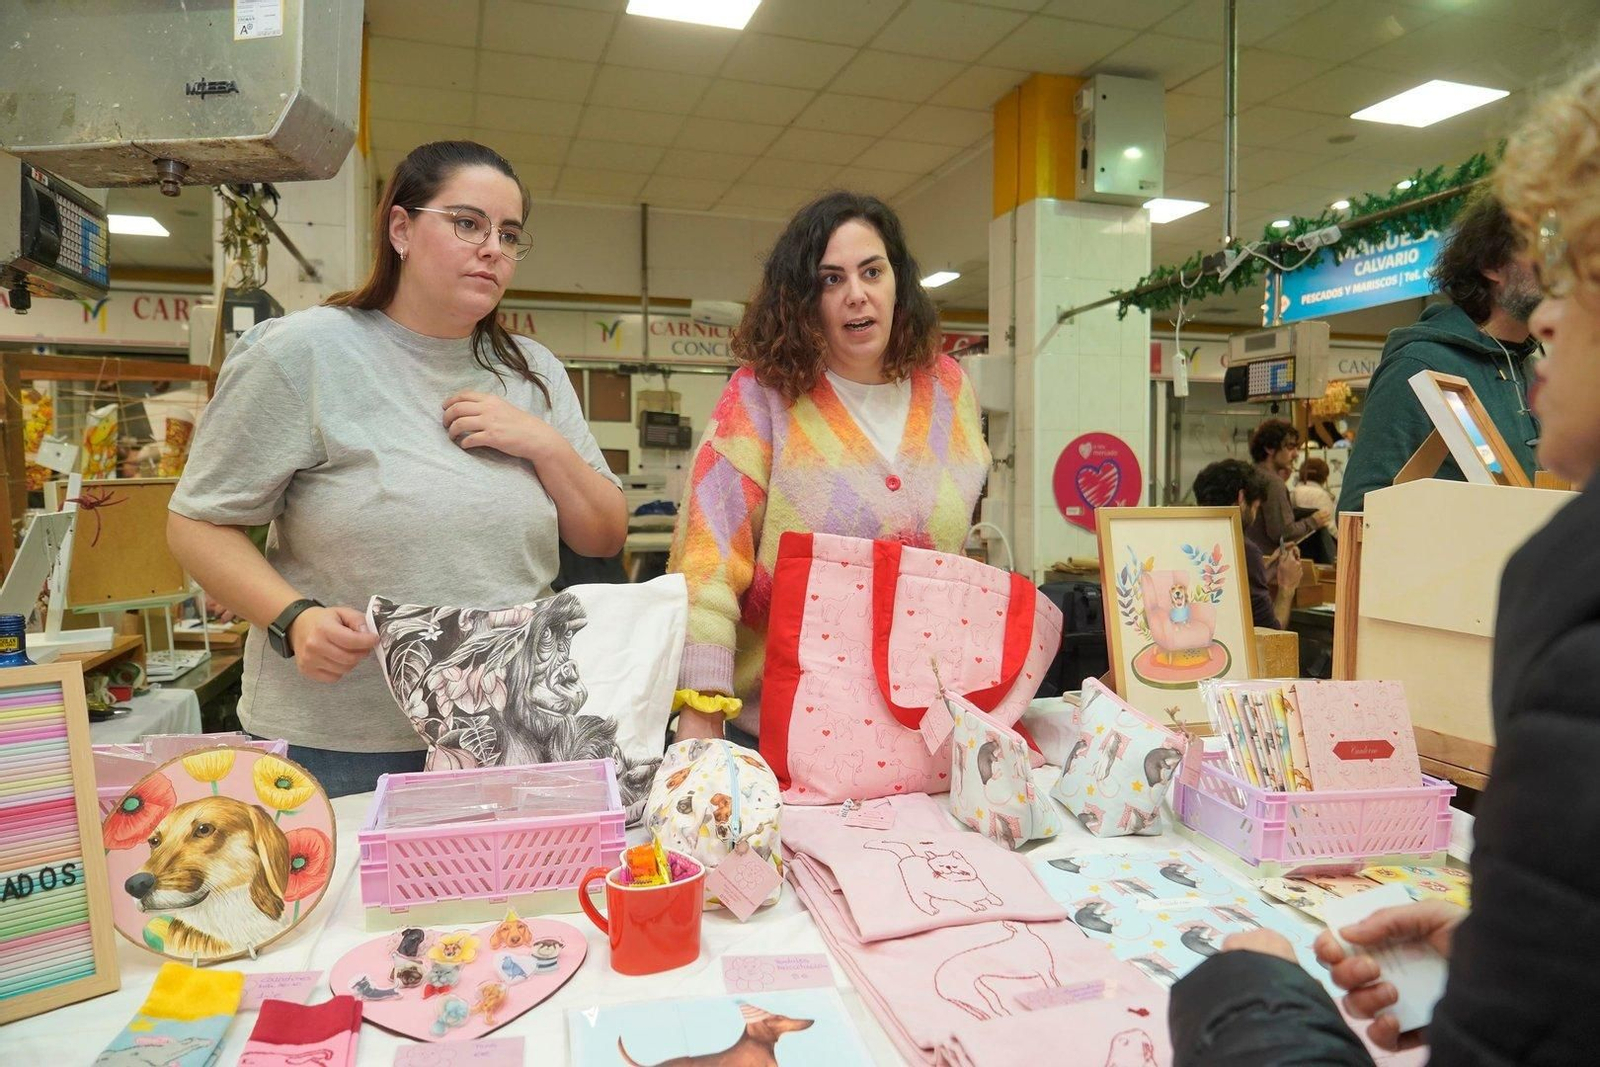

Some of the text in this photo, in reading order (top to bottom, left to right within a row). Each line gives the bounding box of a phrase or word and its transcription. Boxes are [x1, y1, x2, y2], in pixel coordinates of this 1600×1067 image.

[1354, 248, 1419, 276] CALVARIO
[1301, 286, 1343, 305] PESCADOS
[1344, 284, 1351, 295] Y
[1352, 275, 1398, 294] MARISCOS
